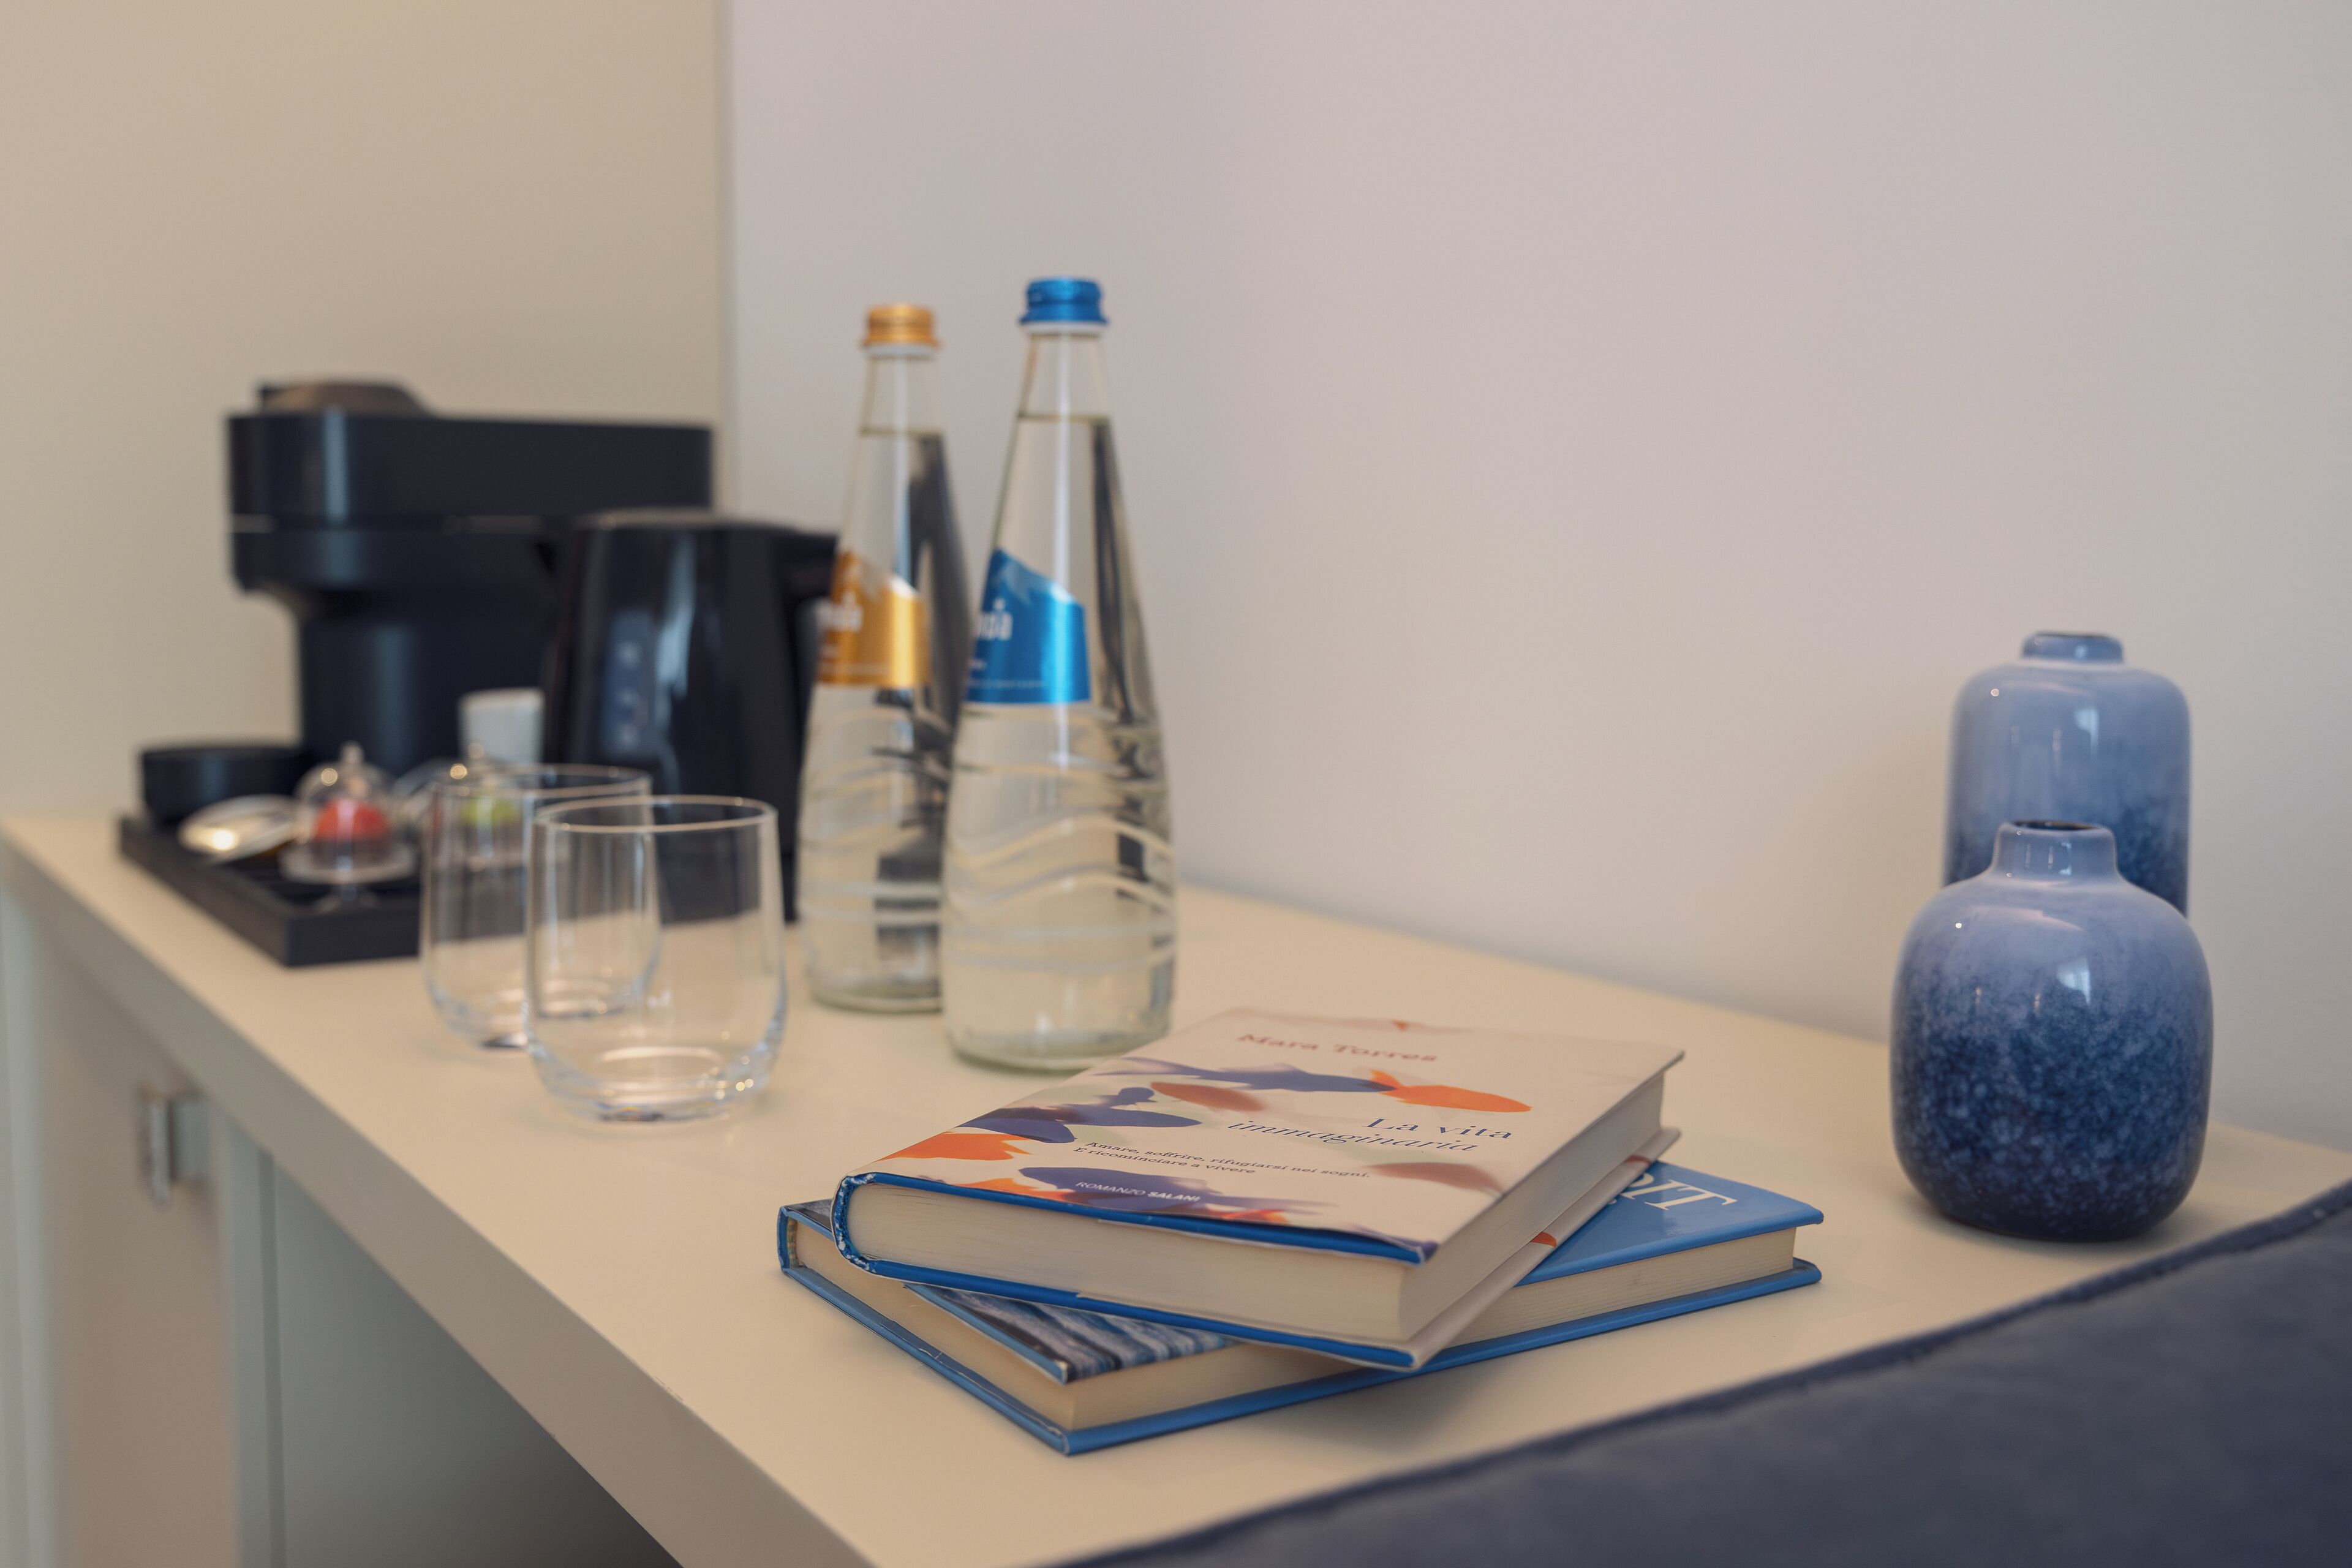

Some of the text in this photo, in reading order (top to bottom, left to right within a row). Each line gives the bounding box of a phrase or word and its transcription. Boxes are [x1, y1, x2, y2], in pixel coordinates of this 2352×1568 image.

[1236, 1033, 1438, 1061] Mara Torres
[1227, 1120, 1479, 1152] immaginaria
[1365, 1118, 1512, 1139] La vita
[1085, 1142, 1139, 1154] Amare,
[1144, 1150, 1205, 1163] soffrire,
[1210, 1158, 1287, 1170] rifugiarsi
[1320, 1169, 1370, 1178] sogni.
[1087, 1149, 1188, 1166] ricominciare
[1205, 1164, 1256, 1174] vivere
[1076, 1181, 1201, 1202] ROMANZO SALANI
